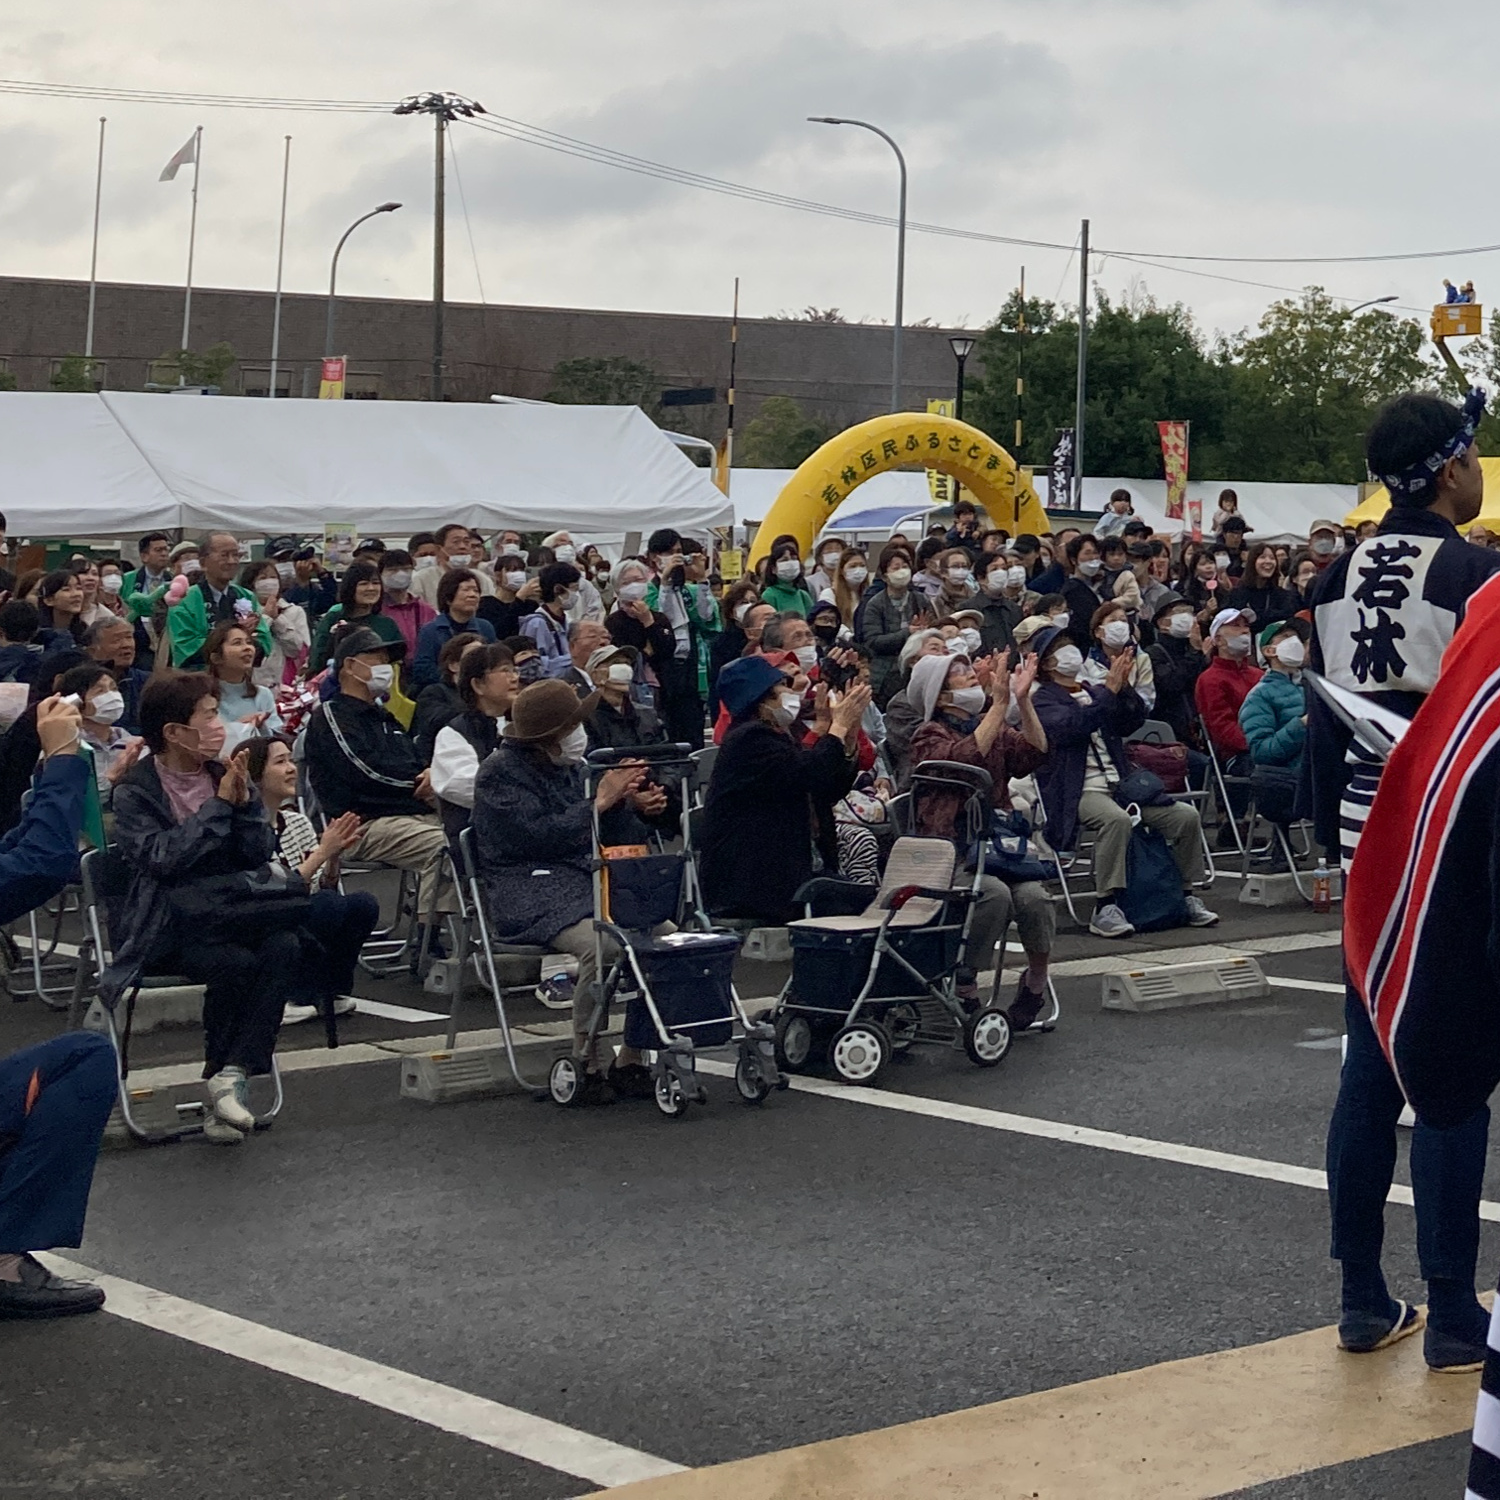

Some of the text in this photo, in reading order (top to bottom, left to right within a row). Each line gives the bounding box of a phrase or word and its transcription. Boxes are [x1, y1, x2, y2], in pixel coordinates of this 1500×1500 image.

[821, 431, 1032, 506] 若林区民ふるさとまつり
[1350, 539, 1422, 685] 若林
